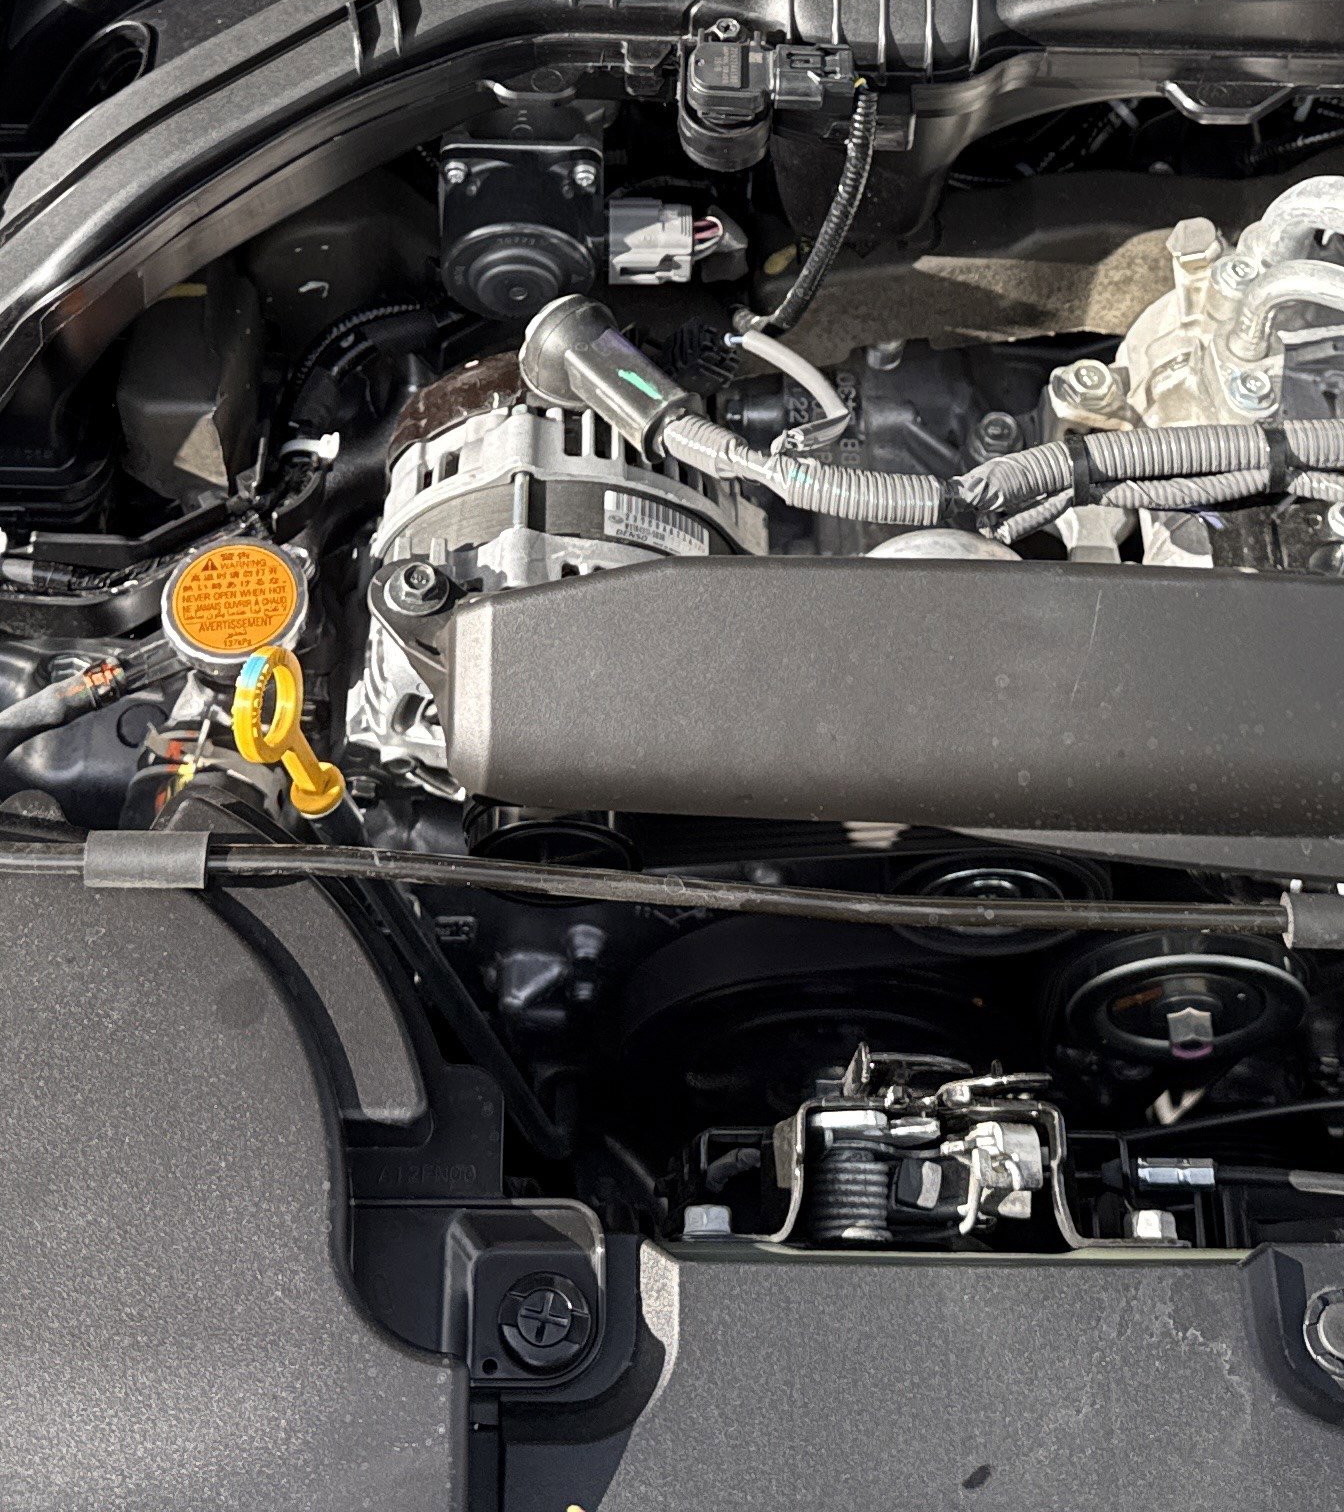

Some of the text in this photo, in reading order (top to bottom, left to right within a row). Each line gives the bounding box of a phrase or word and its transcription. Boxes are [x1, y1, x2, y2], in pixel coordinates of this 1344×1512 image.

[616, 528, 648, 542] DENSO
[220, 558, 267, 569] WARNING
[182, 592, 210, 603] NEVER
[213, 590, 237, 600] OPEN
[239, 588, 266, 598] WHEN
[198, 615, 273, 633] AVERTISSEMENT
